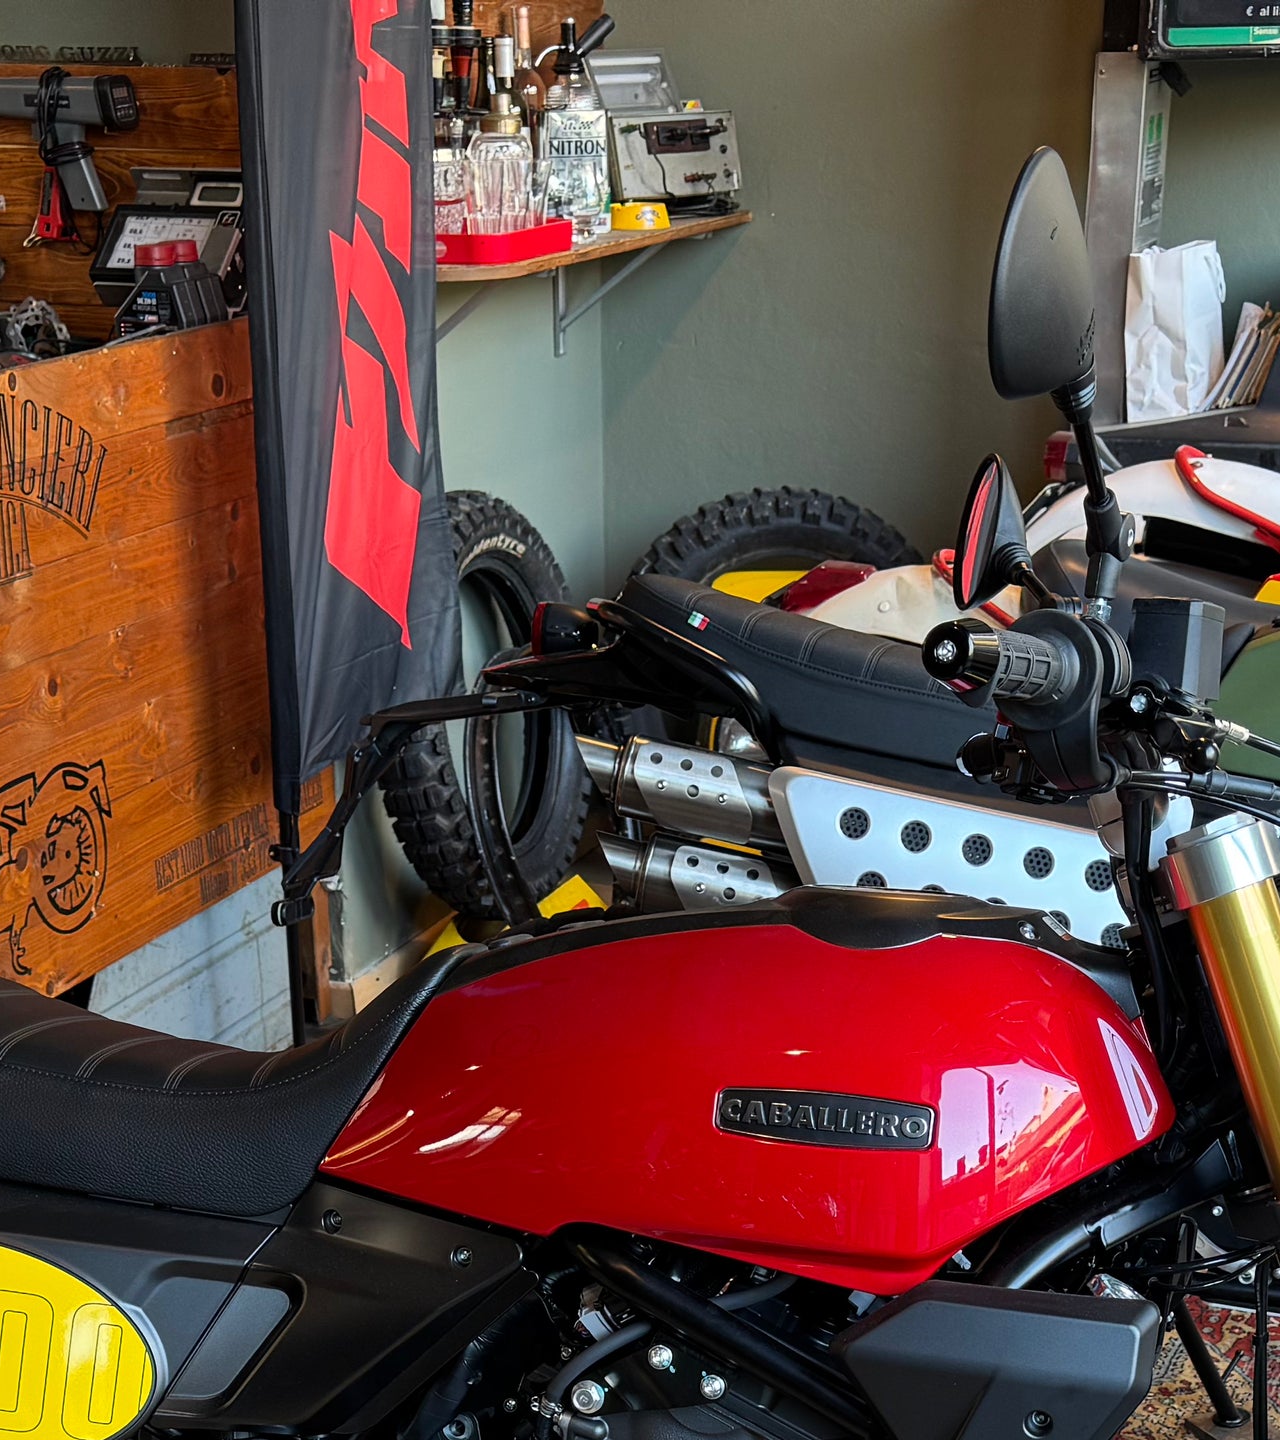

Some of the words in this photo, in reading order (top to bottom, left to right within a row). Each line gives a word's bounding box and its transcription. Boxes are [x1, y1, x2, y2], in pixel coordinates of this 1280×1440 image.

[1246, 6, 1253, 17] €
[1260, 6, 1270, 17] al
[58, 45, 140, 63] GUZZI
[719, 1098, 929, 1140] CABALLERO
